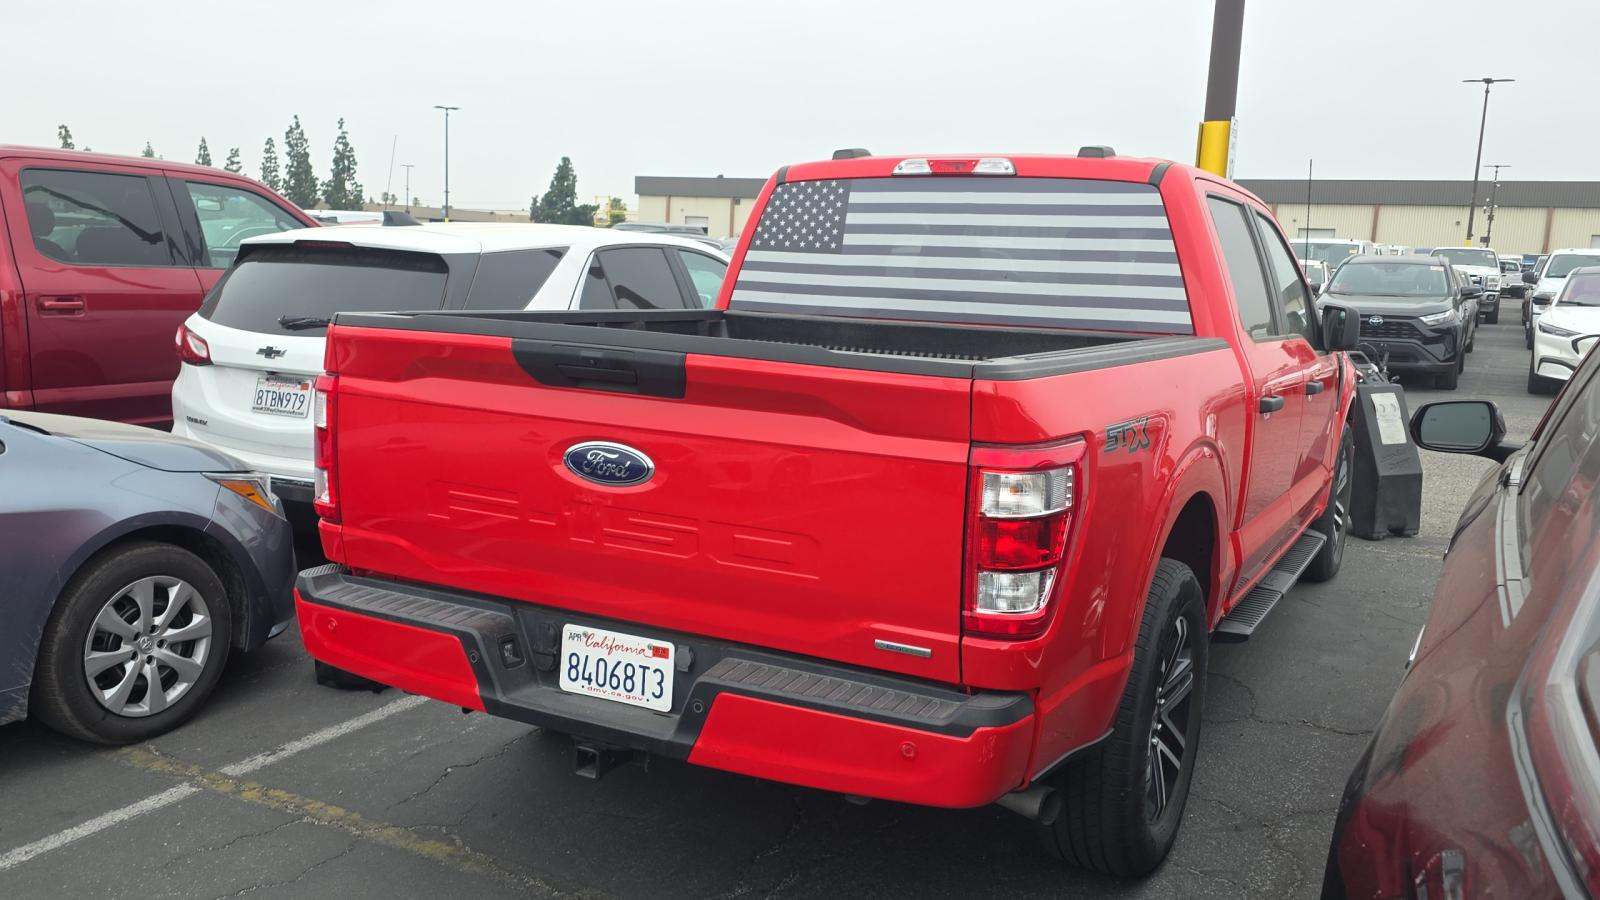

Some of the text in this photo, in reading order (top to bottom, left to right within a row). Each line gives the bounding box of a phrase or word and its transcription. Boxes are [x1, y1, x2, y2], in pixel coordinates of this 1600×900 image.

[256, 389, 306, 410] 8TBN979
[1104, 416, 1150, 453] STX
[582, 450, 631, 478] Ford
[585, 632, 653, 659] California
[567, 652, 665, 698] 84068T3
[587, 685, 643, 702] dmv.ca.gov
